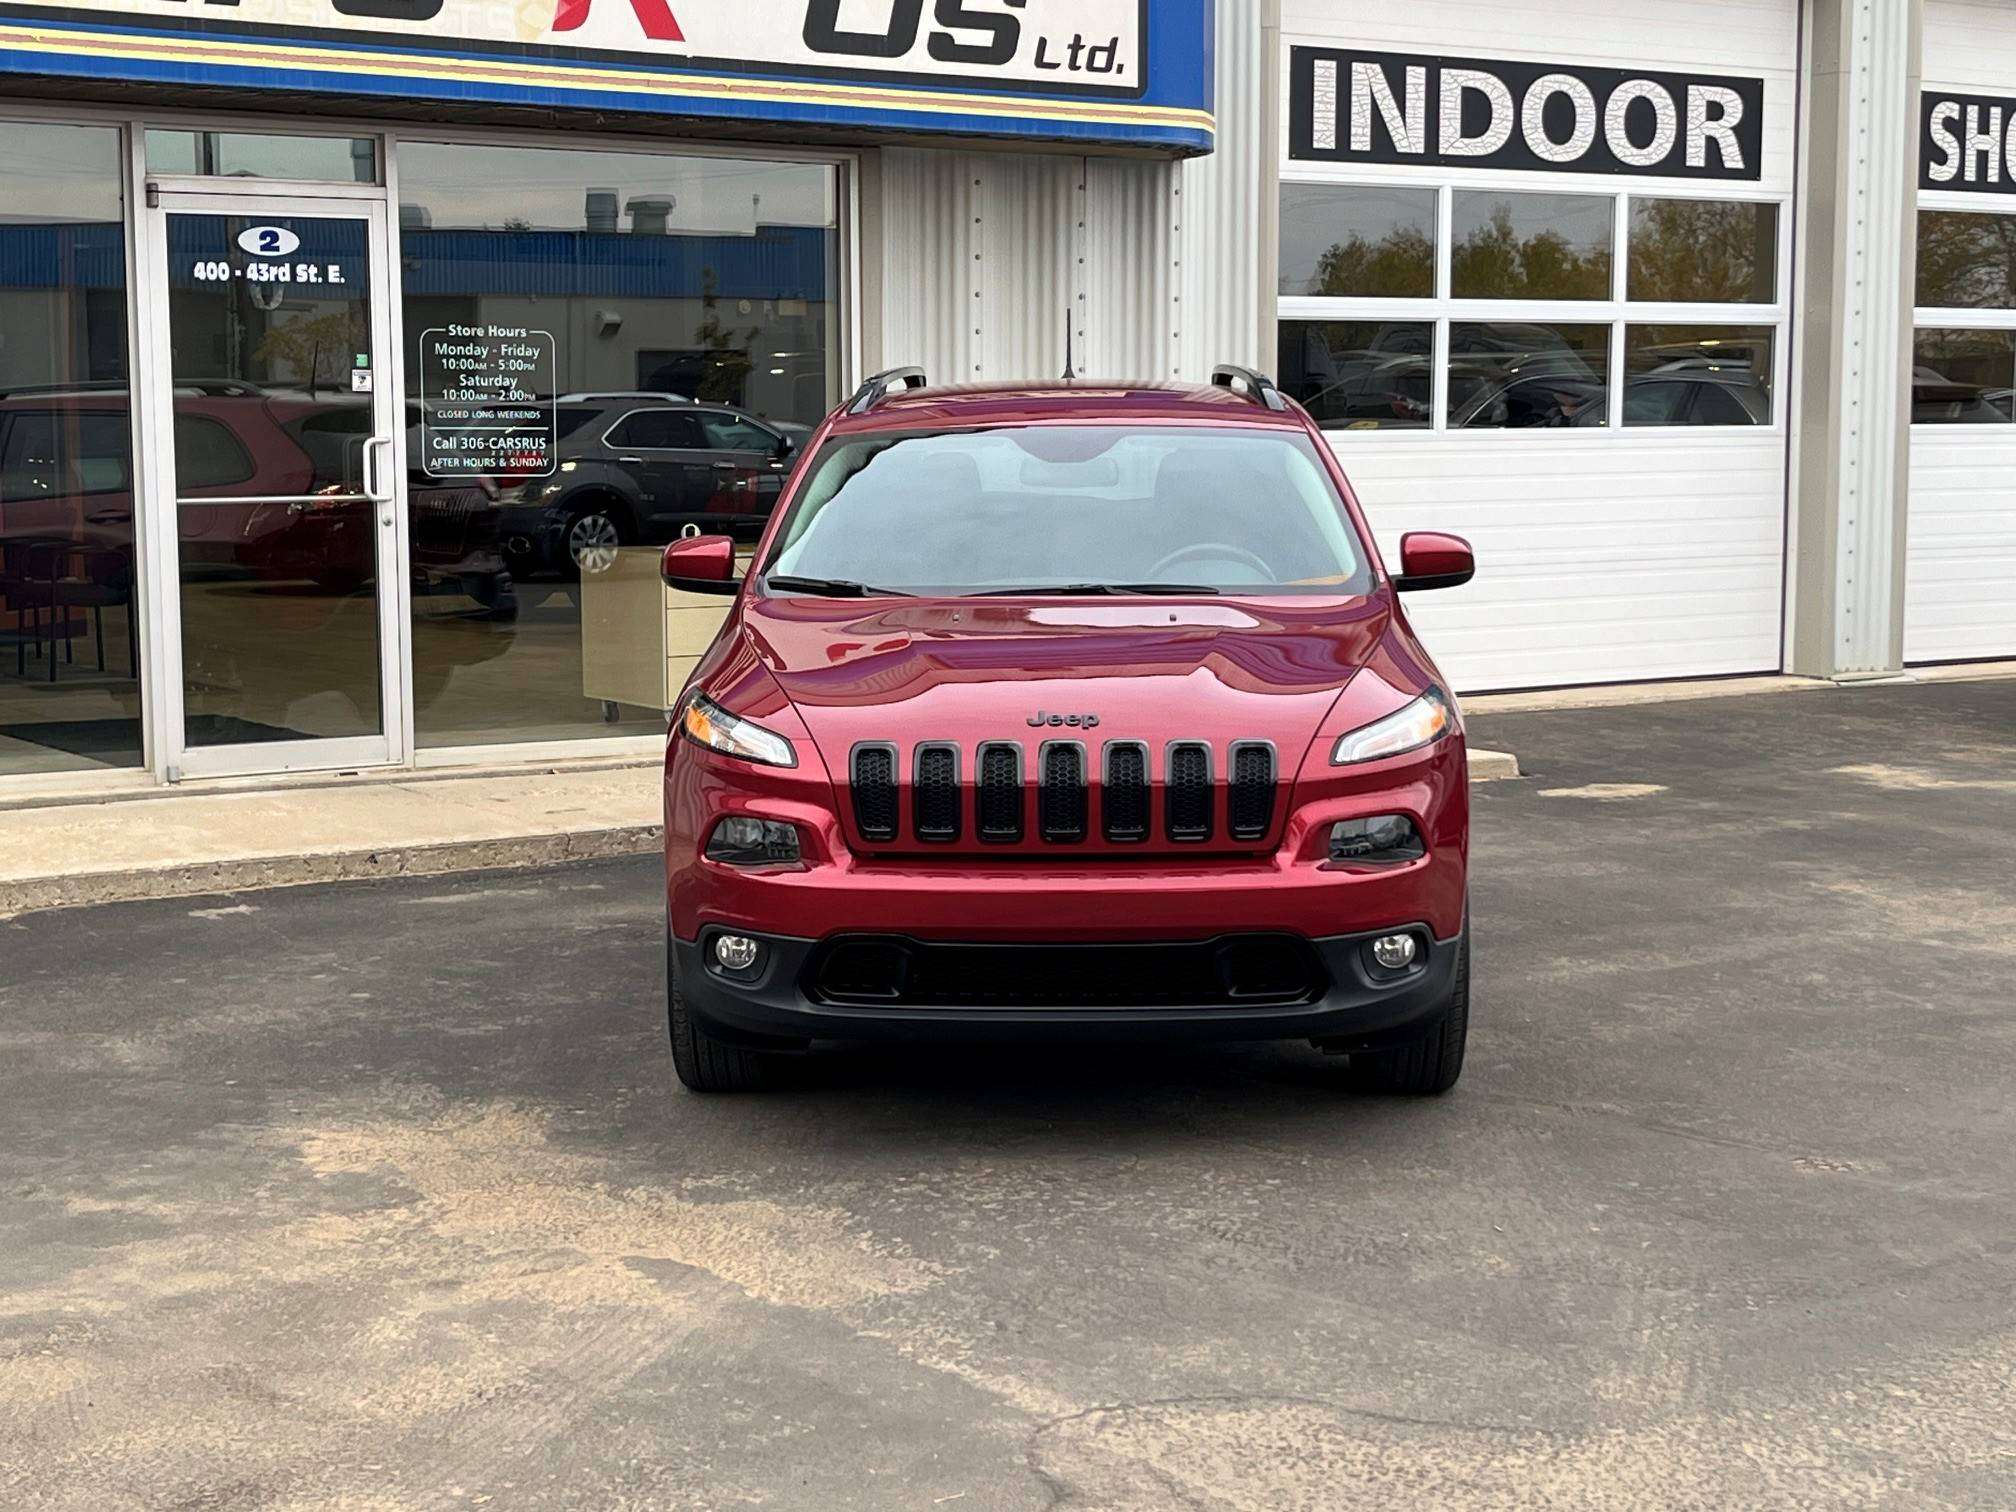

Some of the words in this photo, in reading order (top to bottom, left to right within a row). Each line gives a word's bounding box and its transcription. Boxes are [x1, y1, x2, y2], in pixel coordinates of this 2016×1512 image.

[1034, 33, 1124, 75] Ltd.
[1312, 59, 1745, 169] INDOOR
[259, 229, 280, 252] 2
[193, 261, 230, 282] 400
[246, 262, 291, 283] 43rd
[296, 263, 323, 283] St.
[328, 265, 345, 284] E.
[448, 324, 485, 337] Store
[488, 325, 527, 338] Hours
[434, 342, 489, 358] Monday
[500, 343, 541, 360] Friday
[442, 358, 487, 370] 10:00AM
[498, 359, 536, 371] 5:00PM
[459, 374, 518, 389] Saturday
[442, 389, 488, 401] 10:00AM
[498, 389, 536, 401] 2:00PM
[437, 410, 469, 419] CLOSED
[471, 410, 495, 419] LONG
[497, 410, 541, 419] WEEKENDS
[433, 437, 457, 449] Call
[460, 437, 546, 450] 306-CARSRUS
[430, 457, 460, 467] AFTER
[463, 457, 496, 467] HOURS
[499, 457, 507, 467] &
[509, 457, 549, 467] SUNDAY
[1026, 710, 1100, 730] Jeep
